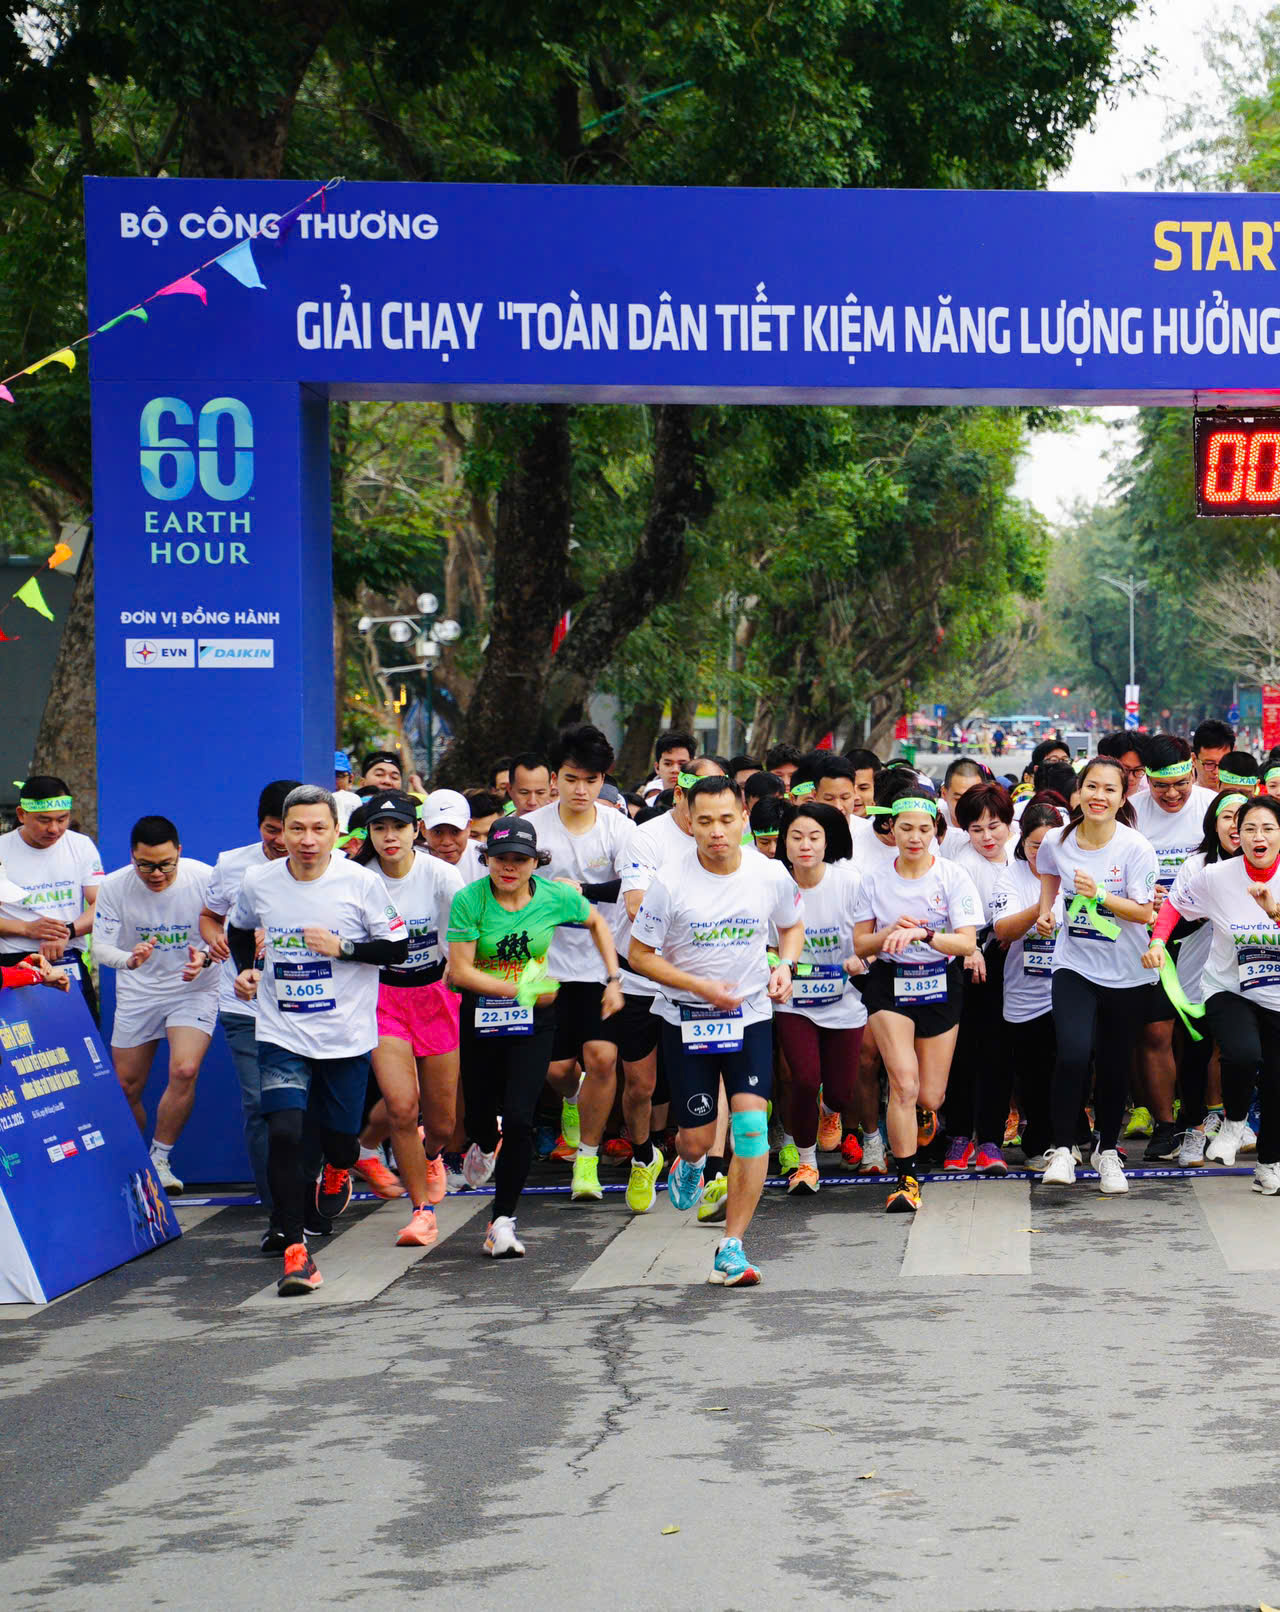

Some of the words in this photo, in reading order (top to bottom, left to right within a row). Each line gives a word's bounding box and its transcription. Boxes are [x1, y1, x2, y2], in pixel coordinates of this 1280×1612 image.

[119, 205, 168, 246] BỘ
[178, 205, 281, 240] CÔNG
[298, 208, 439, 240] THƯƠNG
[296, 284, 372, 350] GIẢI
[381, 302, 482, 362] CHẠY
[499, 290, 618, 352] "TOÀN
[632, 291, 707, 352] DÂN
[715, 281, 795, 352] TIẾT
[803, 292, 896, 365] KIỆM
[905, 294, 1008, 354] NĂNG
[1020, 298, 1144, 367] LƯỢNG
[139, 397, 254, 501] 60
[144, 511, 251, 534] EARTH
[151, 542, 250, 565] HOUR
[120, 610, 157, 624] ĐƠN
[161, 611, 177, 628] VỊ
[181, 606, 230, 625] ĐỒNG
[234, 608, 280, 624] HÀNH
[161, 647, 187, 657] EVN
[214, 648, 271, 658] DAIKIN
[1239, 776, 1257, 785] XAN
[913, 799, 937, 815] XAN
[1028, 954, 1053, 966] 22.3
[285, 983, 324, 997] 3.605
[801, 983, 835, 994] 3.662
[904, 979, 938, 992] 3.832
[481, 1009, 529, 1023] 22.193
[692, 1023, 732, 1037] 3.971
